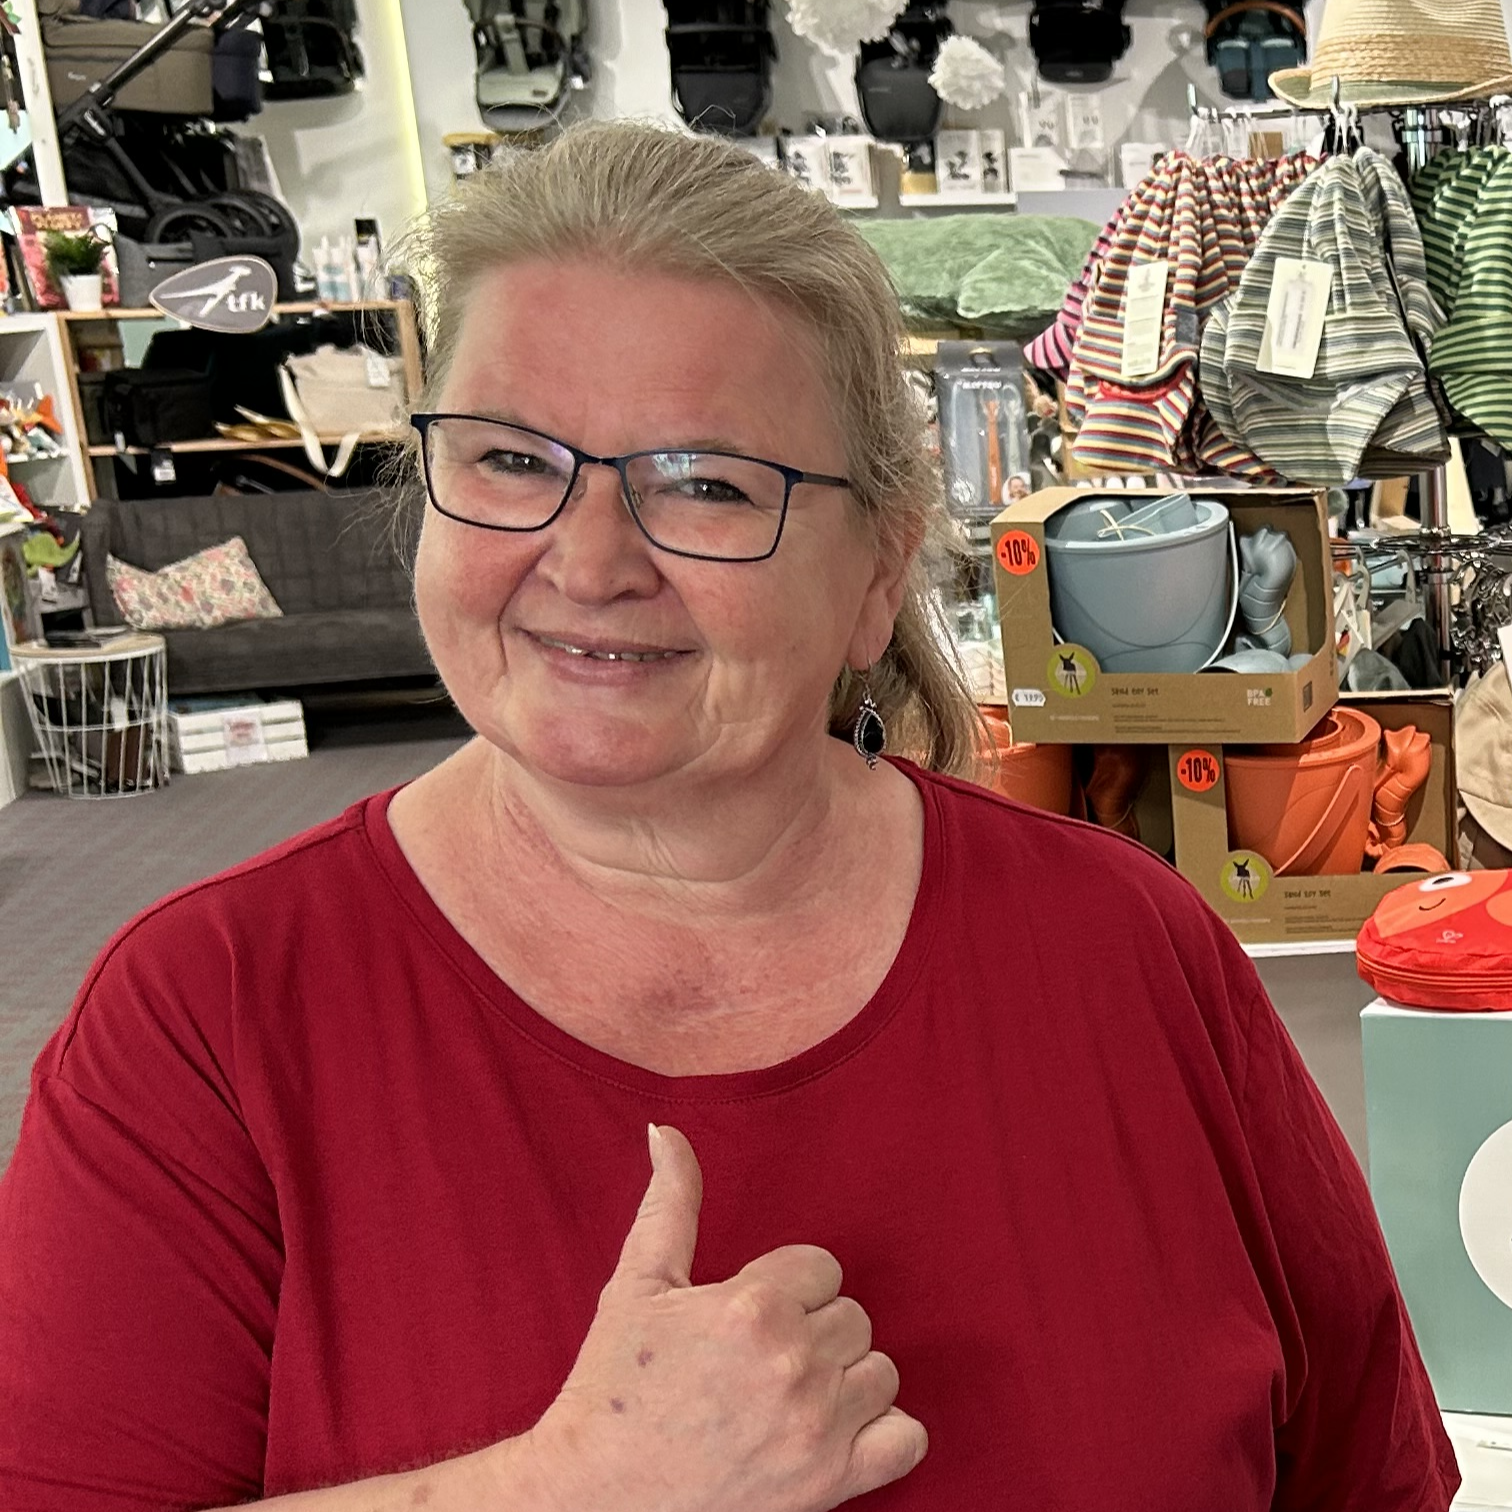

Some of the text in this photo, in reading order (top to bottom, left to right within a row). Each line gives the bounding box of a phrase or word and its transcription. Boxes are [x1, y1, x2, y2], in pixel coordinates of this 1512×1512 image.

[1001, 537, 1036, 567] -10%
[1246, 689, 1265, 698] BPA
[1247, 698, 1271, 706] FREE
[1180, 757, 1216, 784] -10%
